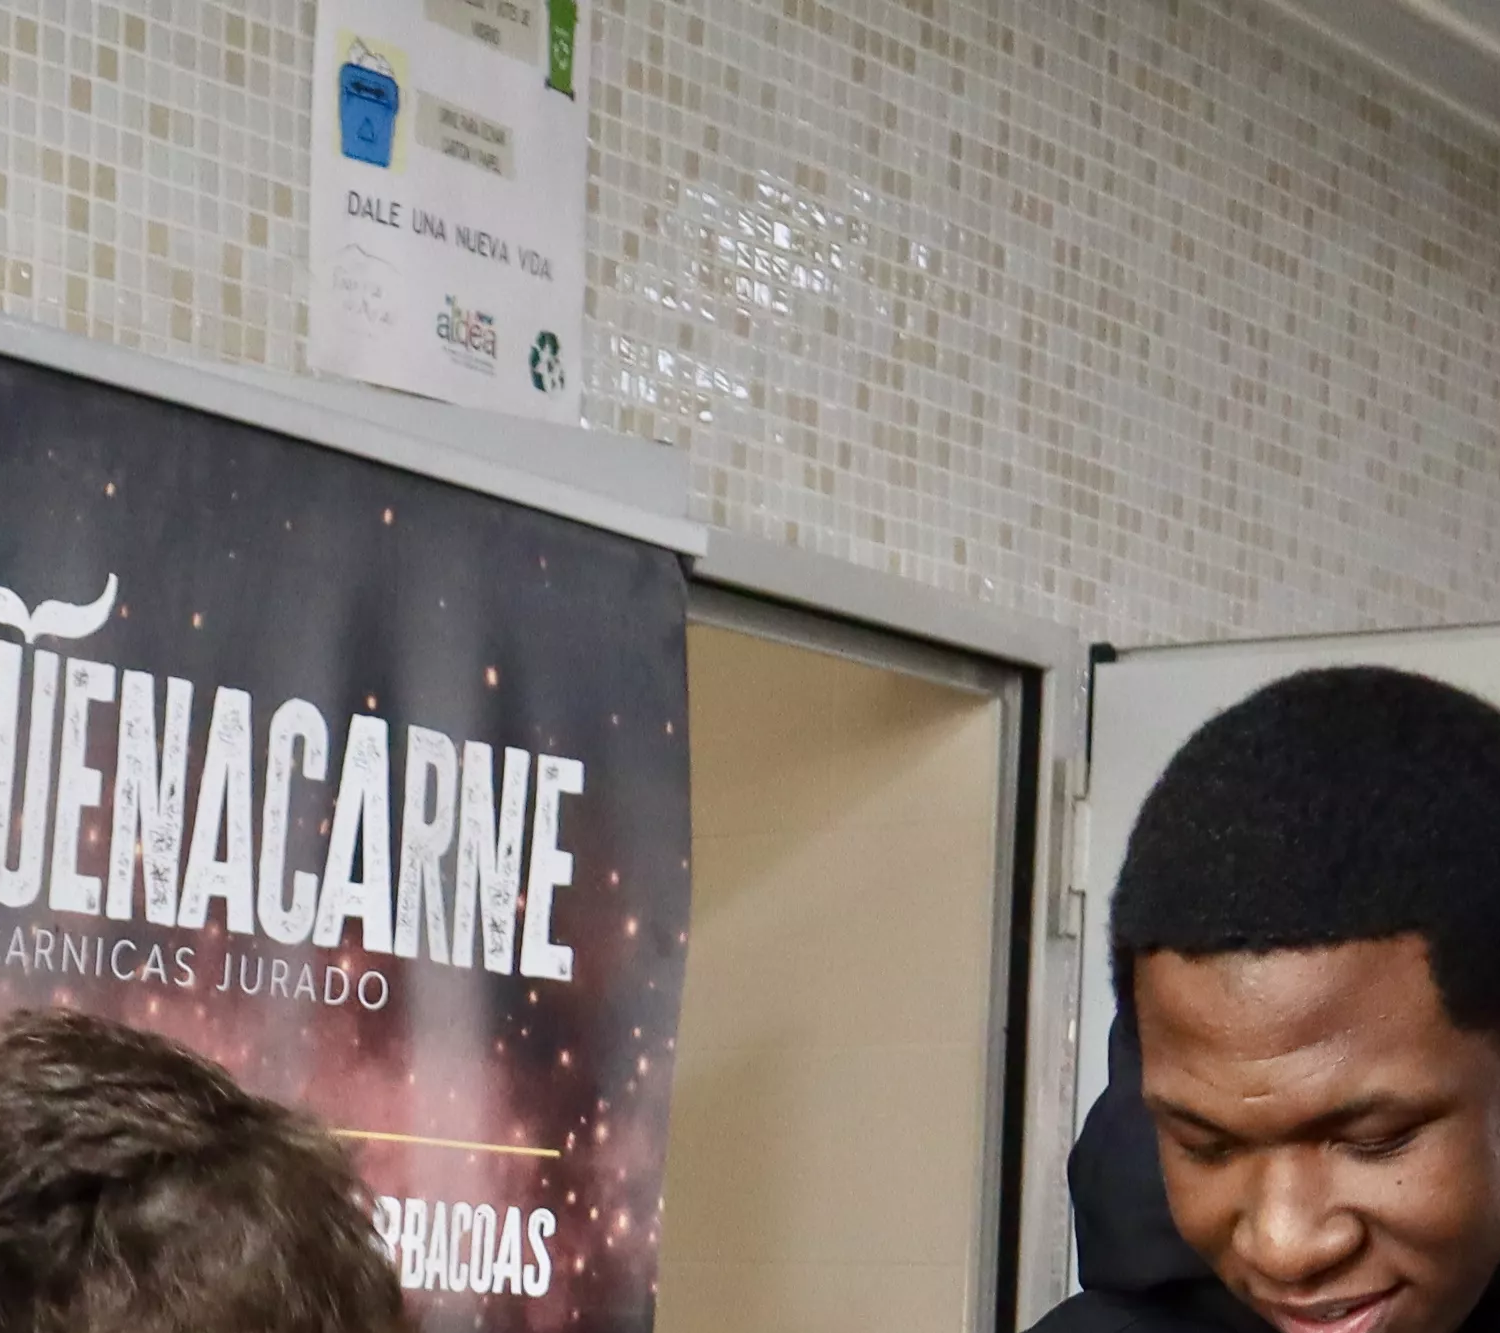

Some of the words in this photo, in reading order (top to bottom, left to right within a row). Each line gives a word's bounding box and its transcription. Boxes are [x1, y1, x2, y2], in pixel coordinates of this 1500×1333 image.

[347, 190, 403, 229] DALE
[412, 207, 447, 242] UNA
[455, 223, 510, 266] NUEVA
[217, 950, 391, 1011] JURADO
